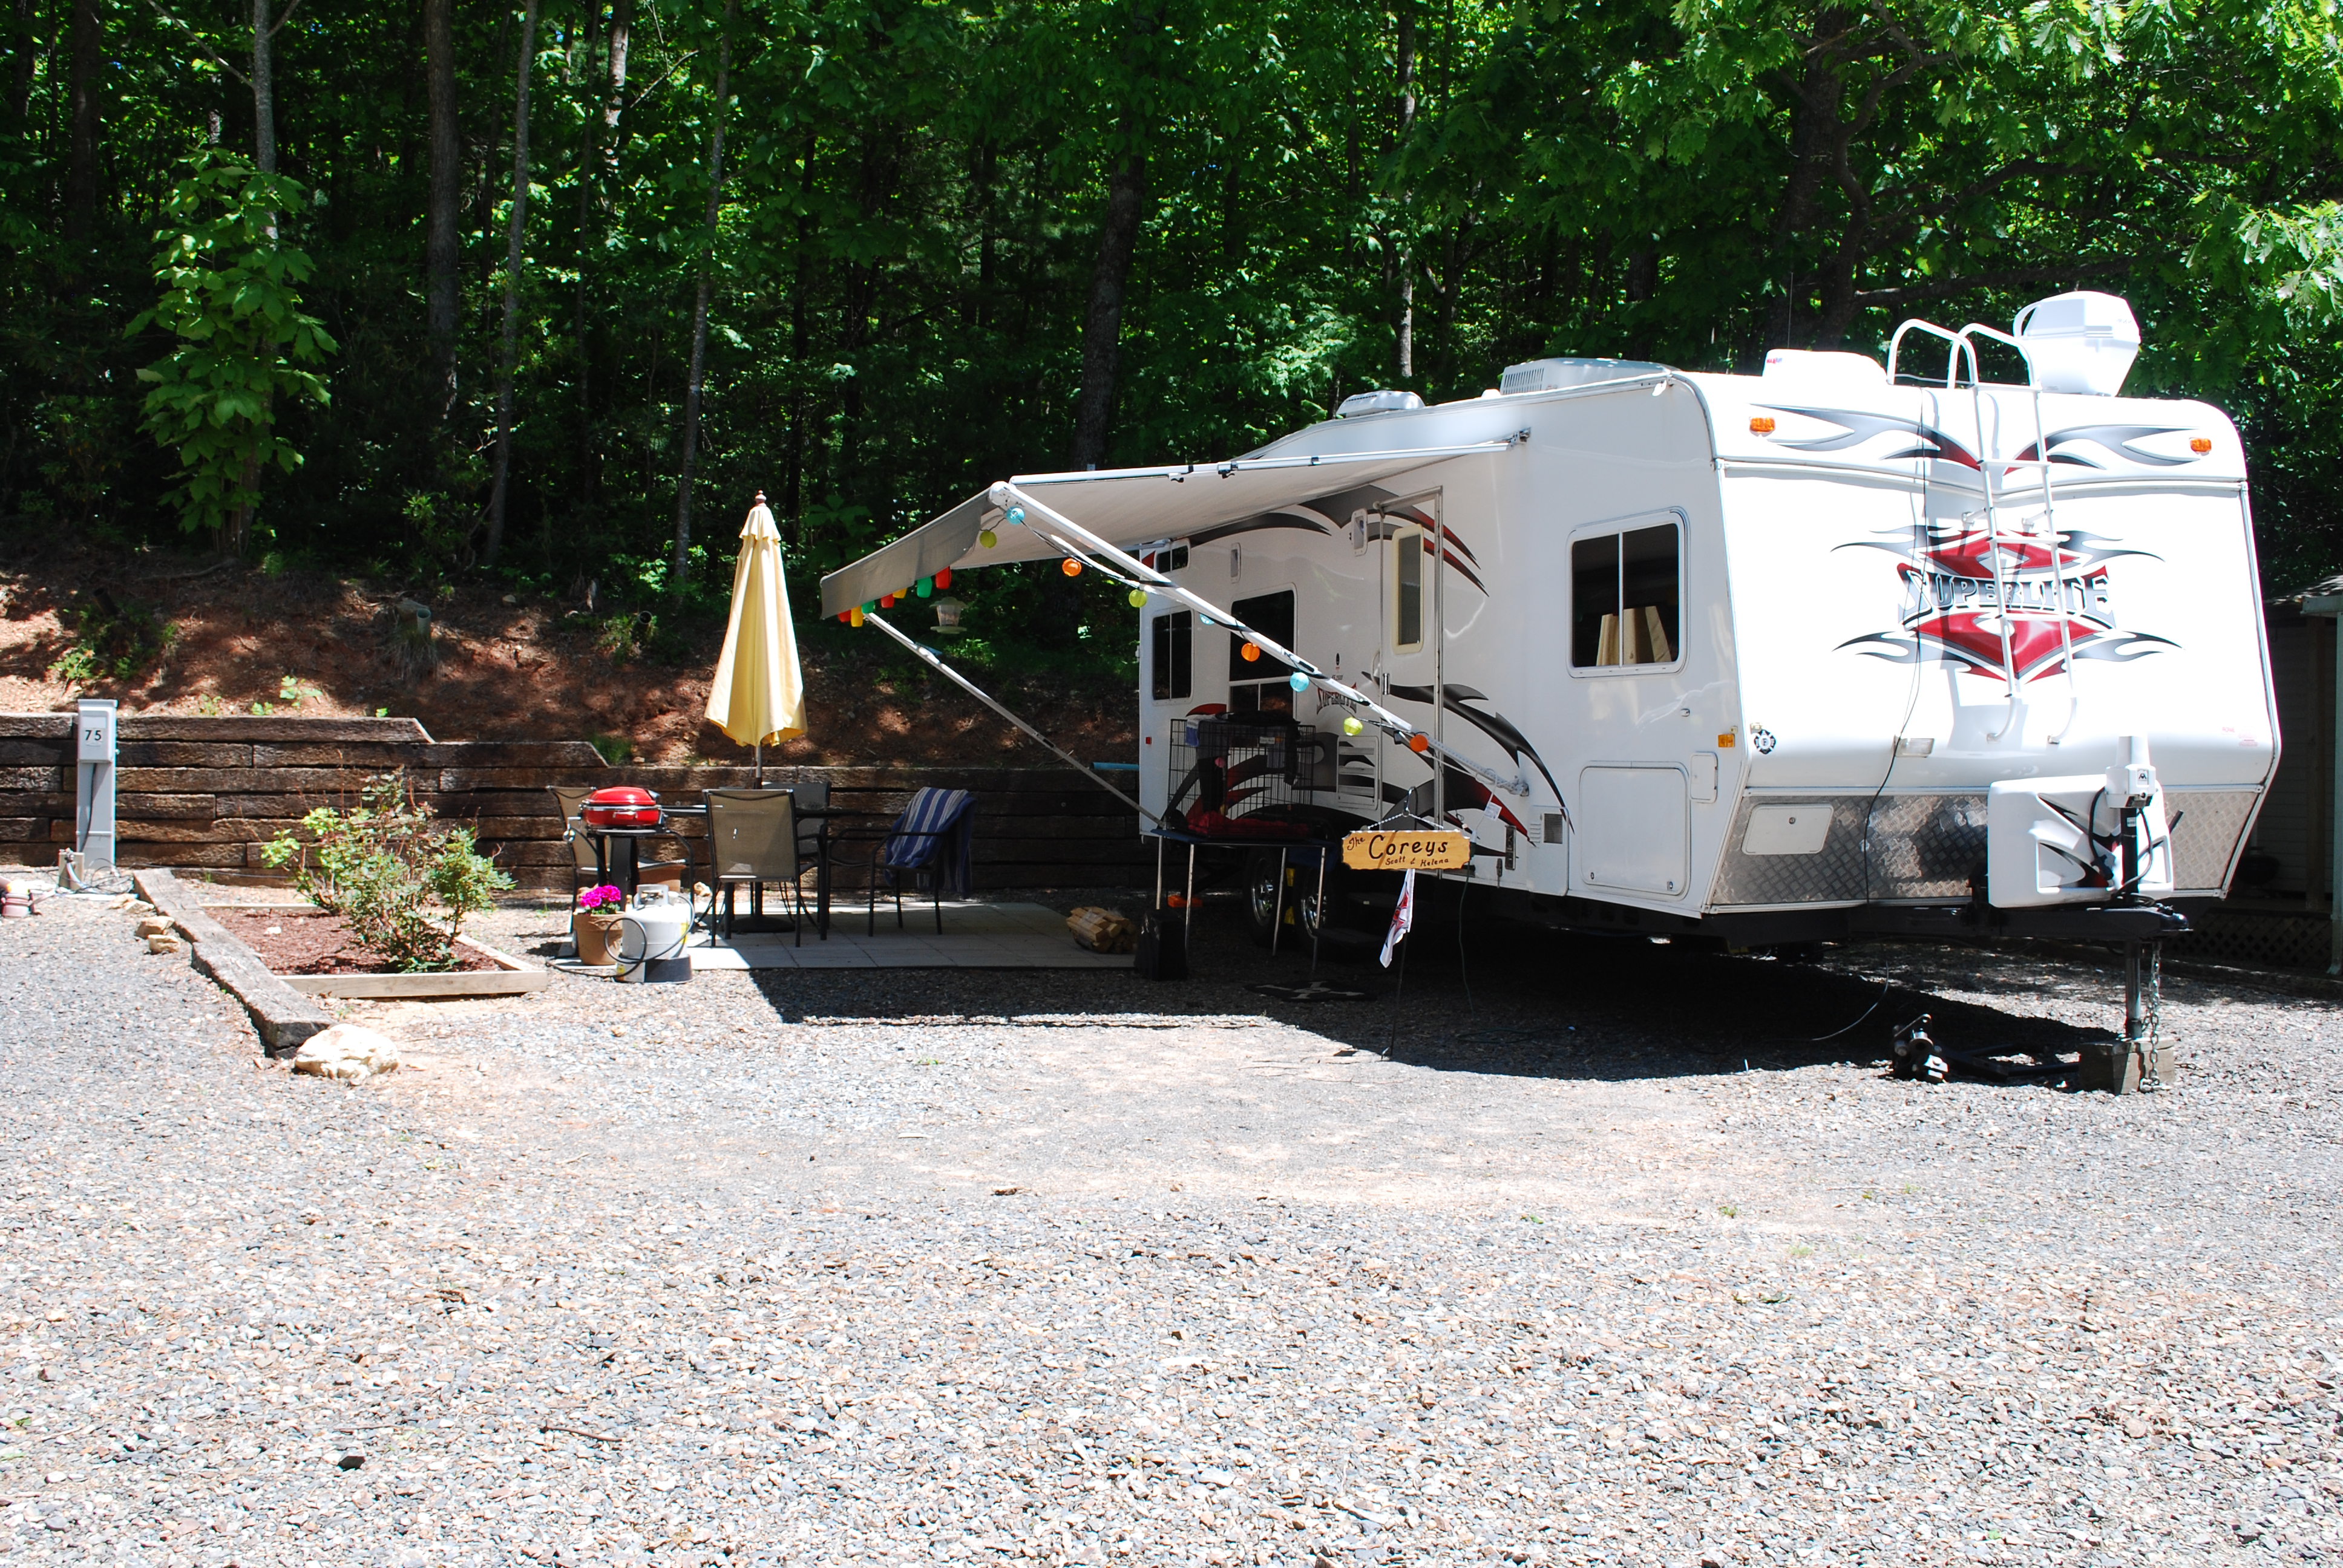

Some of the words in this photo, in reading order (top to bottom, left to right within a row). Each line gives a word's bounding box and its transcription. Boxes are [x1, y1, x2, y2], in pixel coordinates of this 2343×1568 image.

[85, 730, 101, 741] 75
[1347, 837, 1365, 851] The
[1369, 834, 1448, 859] Coreys
[1385, 856, 1406, 866] Scott
[1420, 857, 1449, 867] Helena
